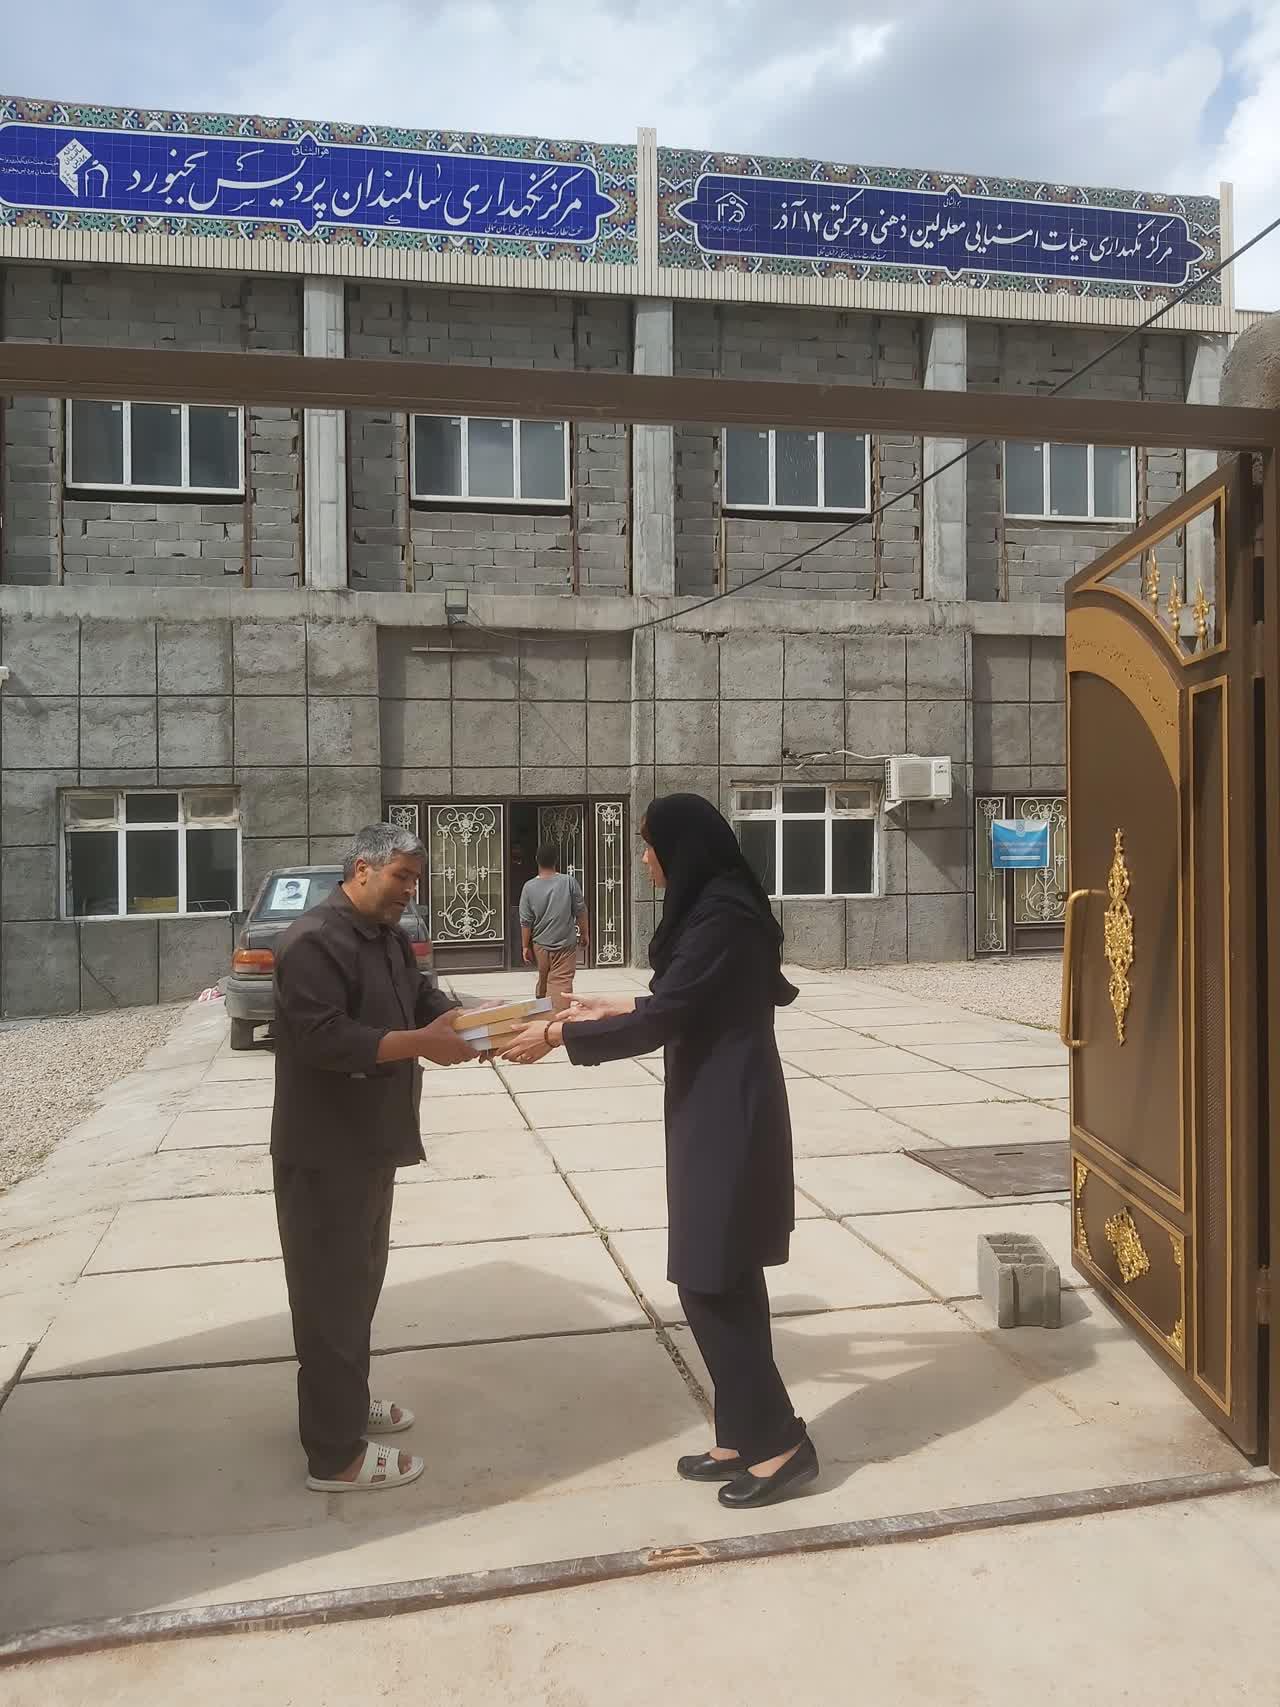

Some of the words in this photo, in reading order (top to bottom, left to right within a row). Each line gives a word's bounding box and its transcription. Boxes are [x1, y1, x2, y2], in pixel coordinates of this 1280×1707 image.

[126, 148, 208, 205] بجنورد
[188, 155, 327, 219] پردیس
[331, 163, 442, 217] سالمندان
[443, 166, 557, 226] نگهداری
[538, 168, 585, 227] مرکز
[772, 198, 807, 231] آذر
[804, 210, 823, 233] ۱۲
[870, 208, 907, 245] ذهنی
[909, 211, 966, 250] معلولین
[1041, 228, 1088, 262] هیأت
[1090, 217, 1157, 262] نگهداری
[1145, 218, 1176, 264] مرکز
